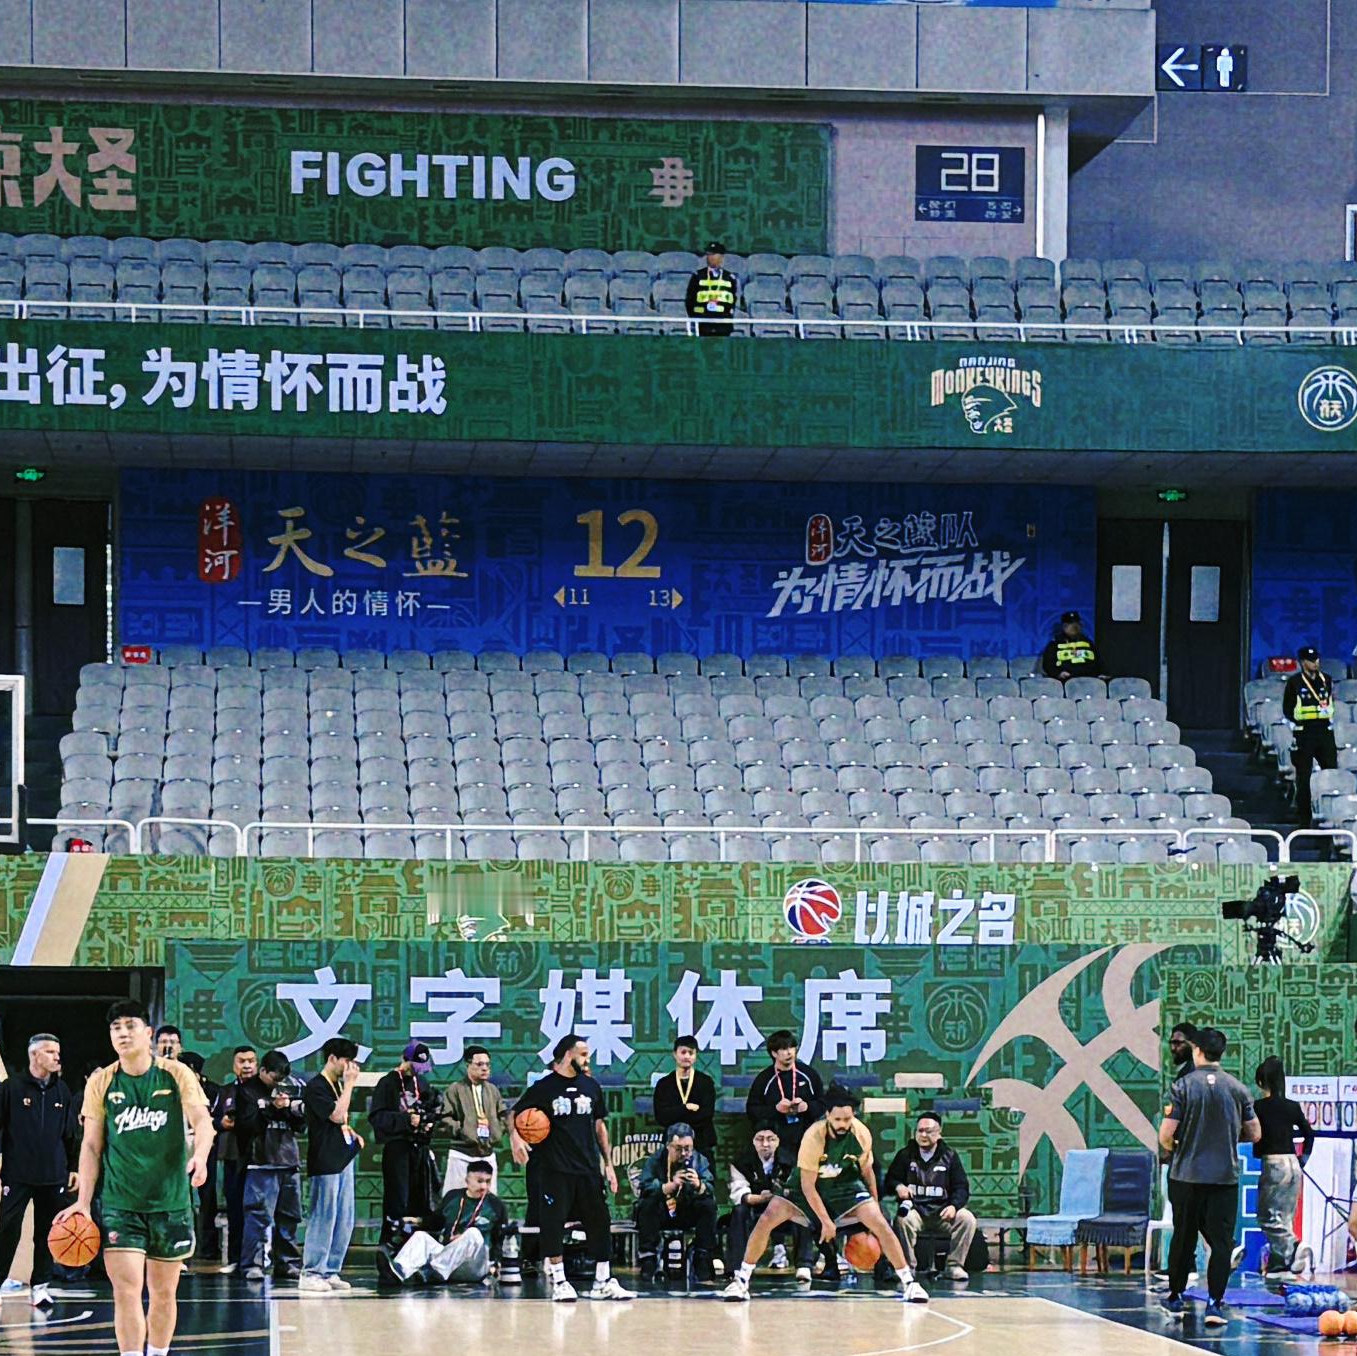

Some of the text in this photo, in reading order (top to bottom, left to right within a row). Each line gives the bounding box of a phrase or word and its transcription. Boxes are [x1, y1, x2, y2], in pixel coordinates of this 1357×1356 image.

[290, 151, 576, 202] FIGHTING
[941, 153, 999, 192] 28
[574, 509, 661, 578] 12
[268, 588, 421, 617] 男人的情怀
[569, 588, 670, 607] 11 13
[765, 550, 1026, 618] 为情怀而战
[854, 889, 1016, 945] 以城之名
[275, 966, 892, 1066] 文字媒体席
